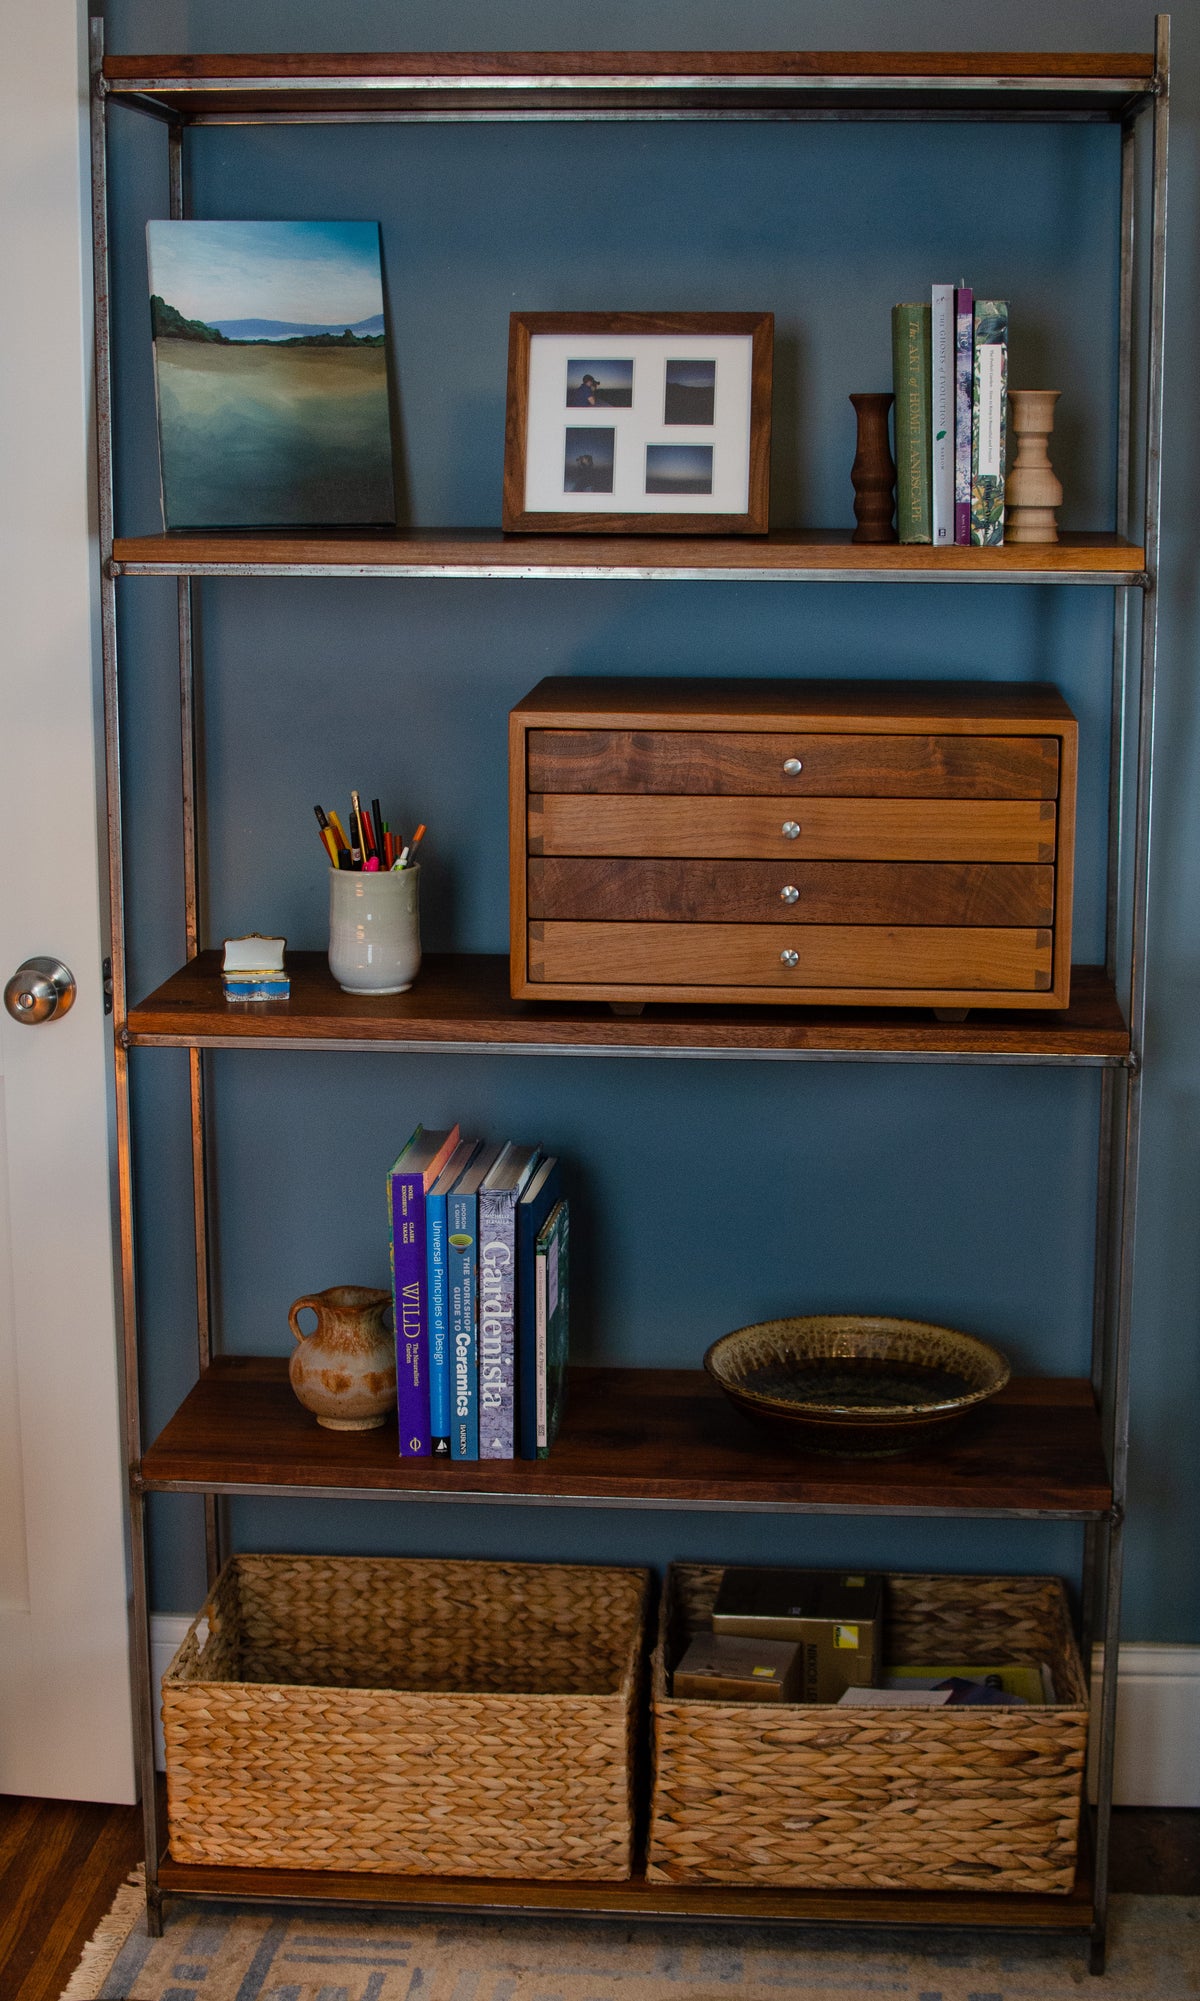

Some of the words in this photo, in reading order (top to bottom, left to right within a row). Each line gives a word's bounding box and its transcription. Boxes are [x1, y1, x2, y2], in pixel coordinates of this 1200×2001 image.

[909, 321, 919, 339] The
[909, 344, 920, 373] ART
[908, 377, 918, 387] of
[910, 393, 920, 434] HOME
[910, 439, 921, 523] LANDSCAPE
[432, 1220, 443, 1265] Universal
[402, 1281, 421, 1338] WILD
[433, 1269, 444, 1317] Principles
[453, 1286, 461, 1316] GUIDE
[463, 1278, 471, 1332] WORKSHOP
[435, 1320, 444, 1329] of
[454, 1319, 461, 1332] TO
[481, 1241, 512, 1410] Gardenista
[434, 1333, 445, 1365] Design
[455, 1333, 472, 1417] Ceramics
[807, 1644, 818, 1684] NIKKOR
